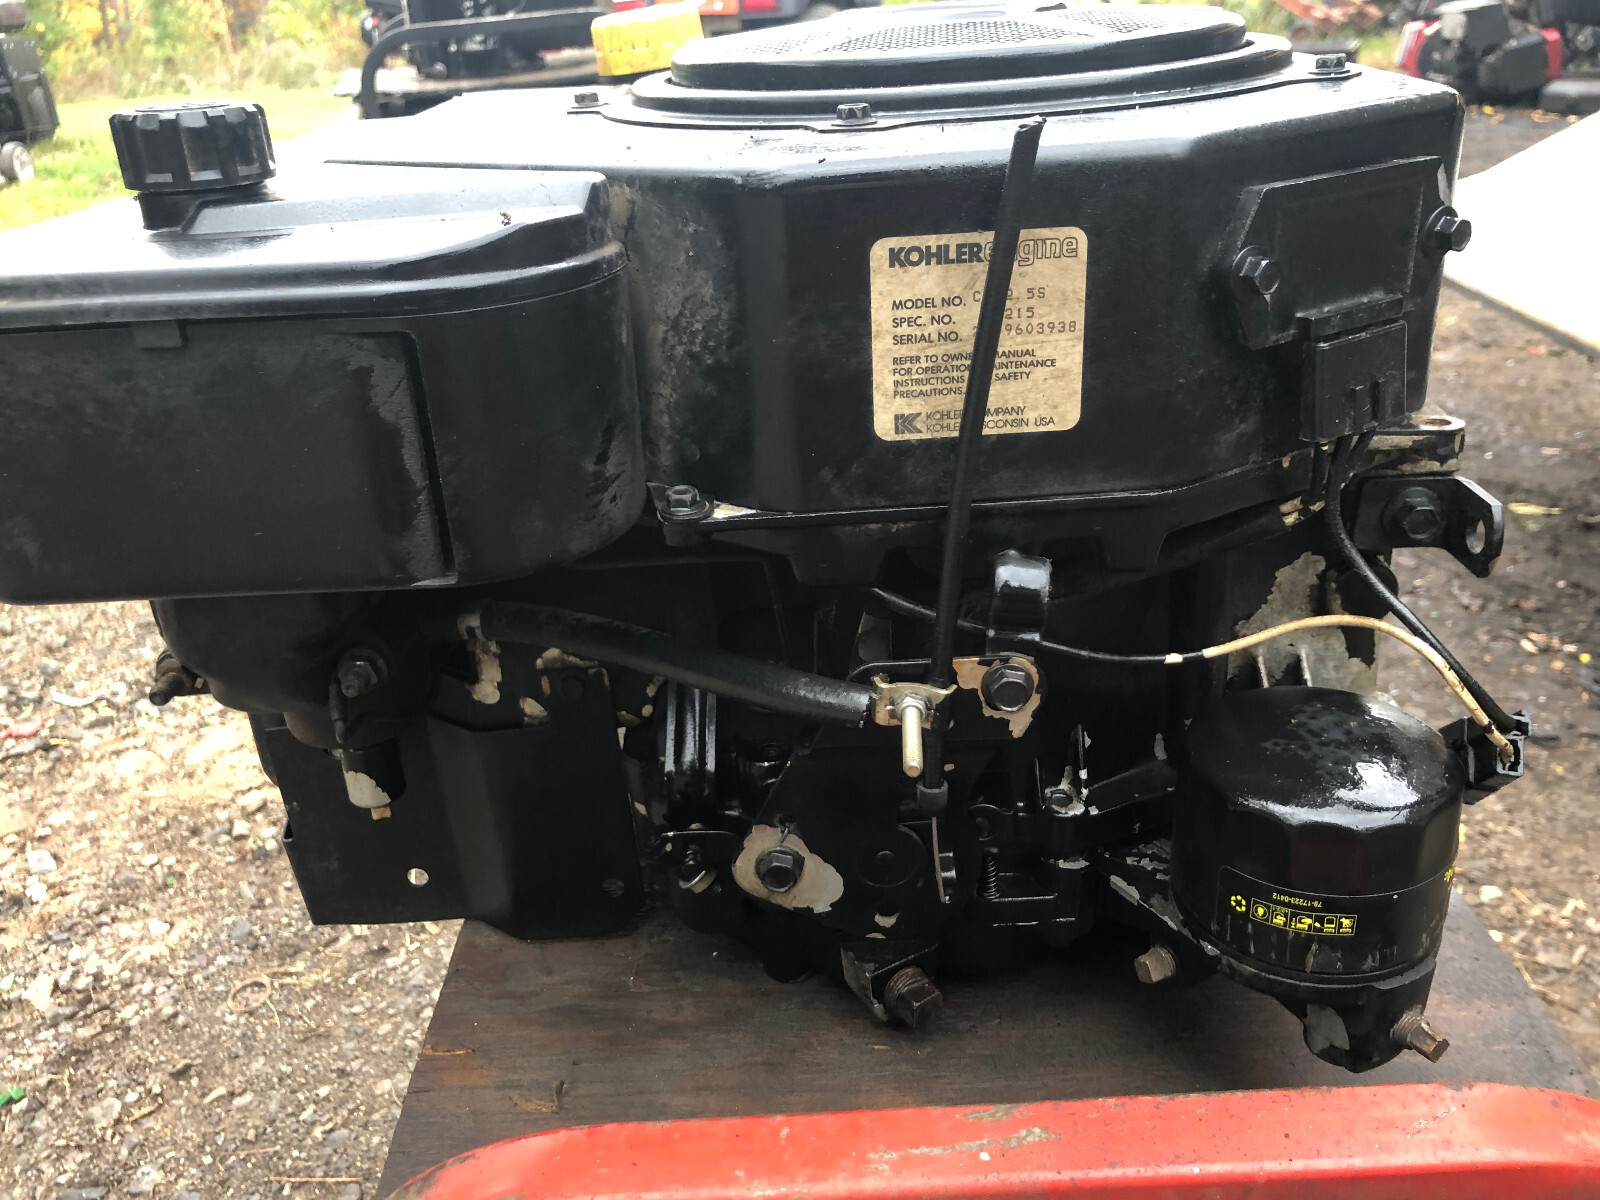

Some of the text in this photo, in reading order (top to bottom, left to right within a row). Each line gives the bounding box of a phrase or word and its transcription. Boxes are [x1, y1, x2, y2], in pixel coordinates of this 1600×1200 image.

[889, 236, 1079, 268] KOHLER egine
[892, 297, 938, 311] MODEL
[941, 295, 967, 308] NO.
[892, 315, 927, 329] SPEC.
[930, 313, 956, 326] NO.
[892, 332, 934, 346] SERIAL
[937, 330, 963, 343] NO.
[892, 355, 922, 366] REFER
[924, 354, 939, 364] TO
[941, 352, 975, 363] OWNE
[892, 367, 913, 377] FOR
[893, 370, 1032, 388] INSTRUCTIONS SAFETY
[893, 386, 966, 399] PRECAUTIONS.
[926, 409, 963, 421] KOHLE
[926, 421, 961, 434] KOHLE
[1034, 416, 1056, 427] USA
